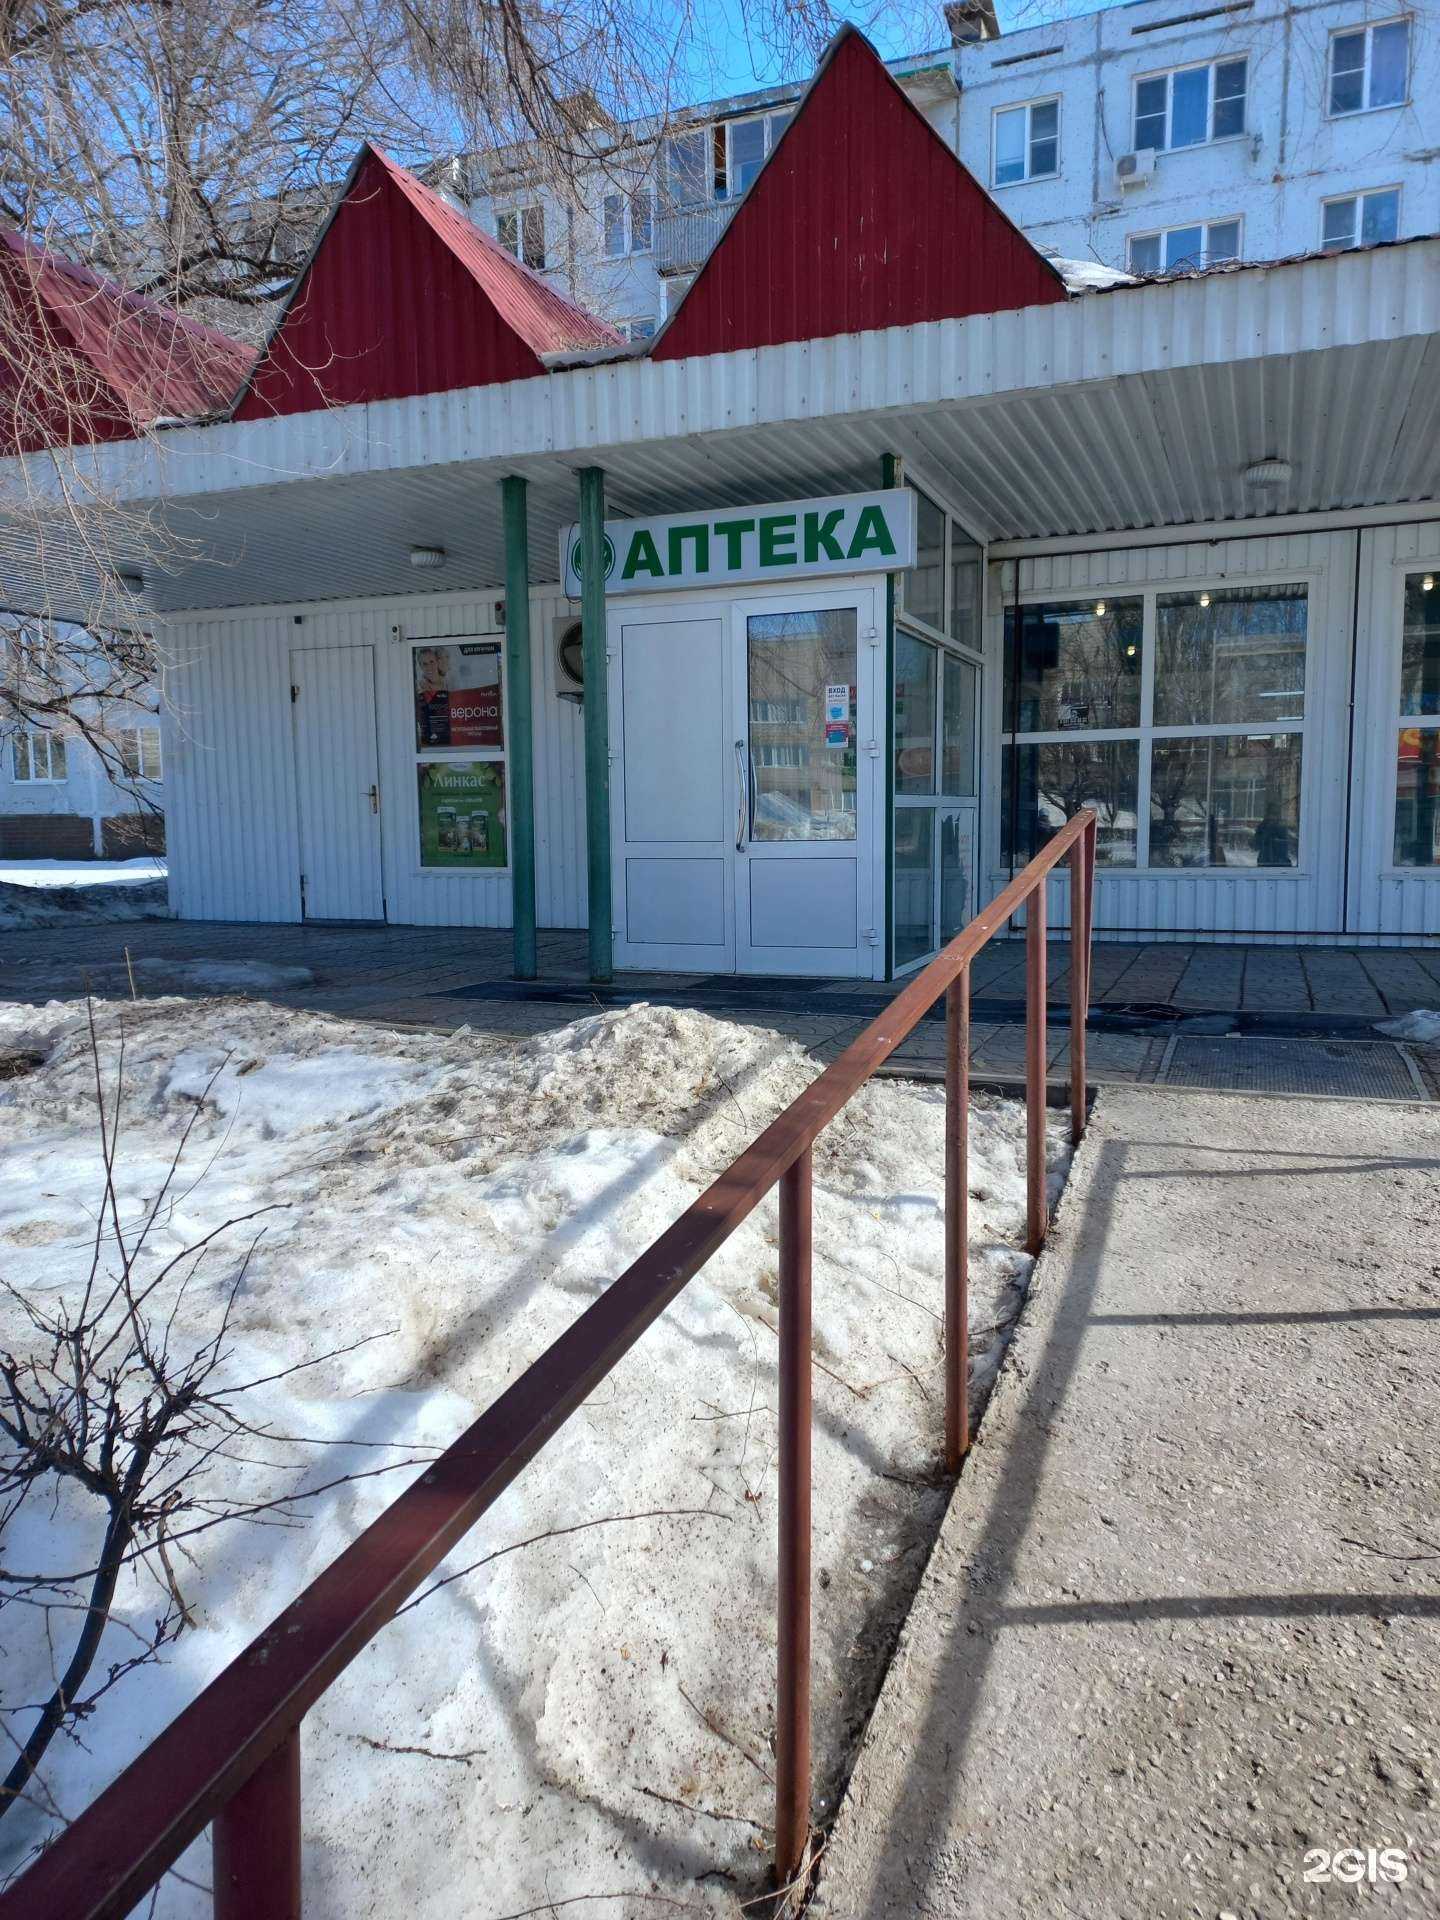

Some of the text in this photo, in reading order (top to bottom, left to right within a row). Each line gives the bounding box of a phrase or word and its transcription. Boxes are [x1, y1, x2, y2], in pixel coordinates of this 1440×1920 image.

[621, 505, 897, 580] АПТЕКА
[450, 705, 498, 720] верона
[433, 775, 488, 789] Линкас
